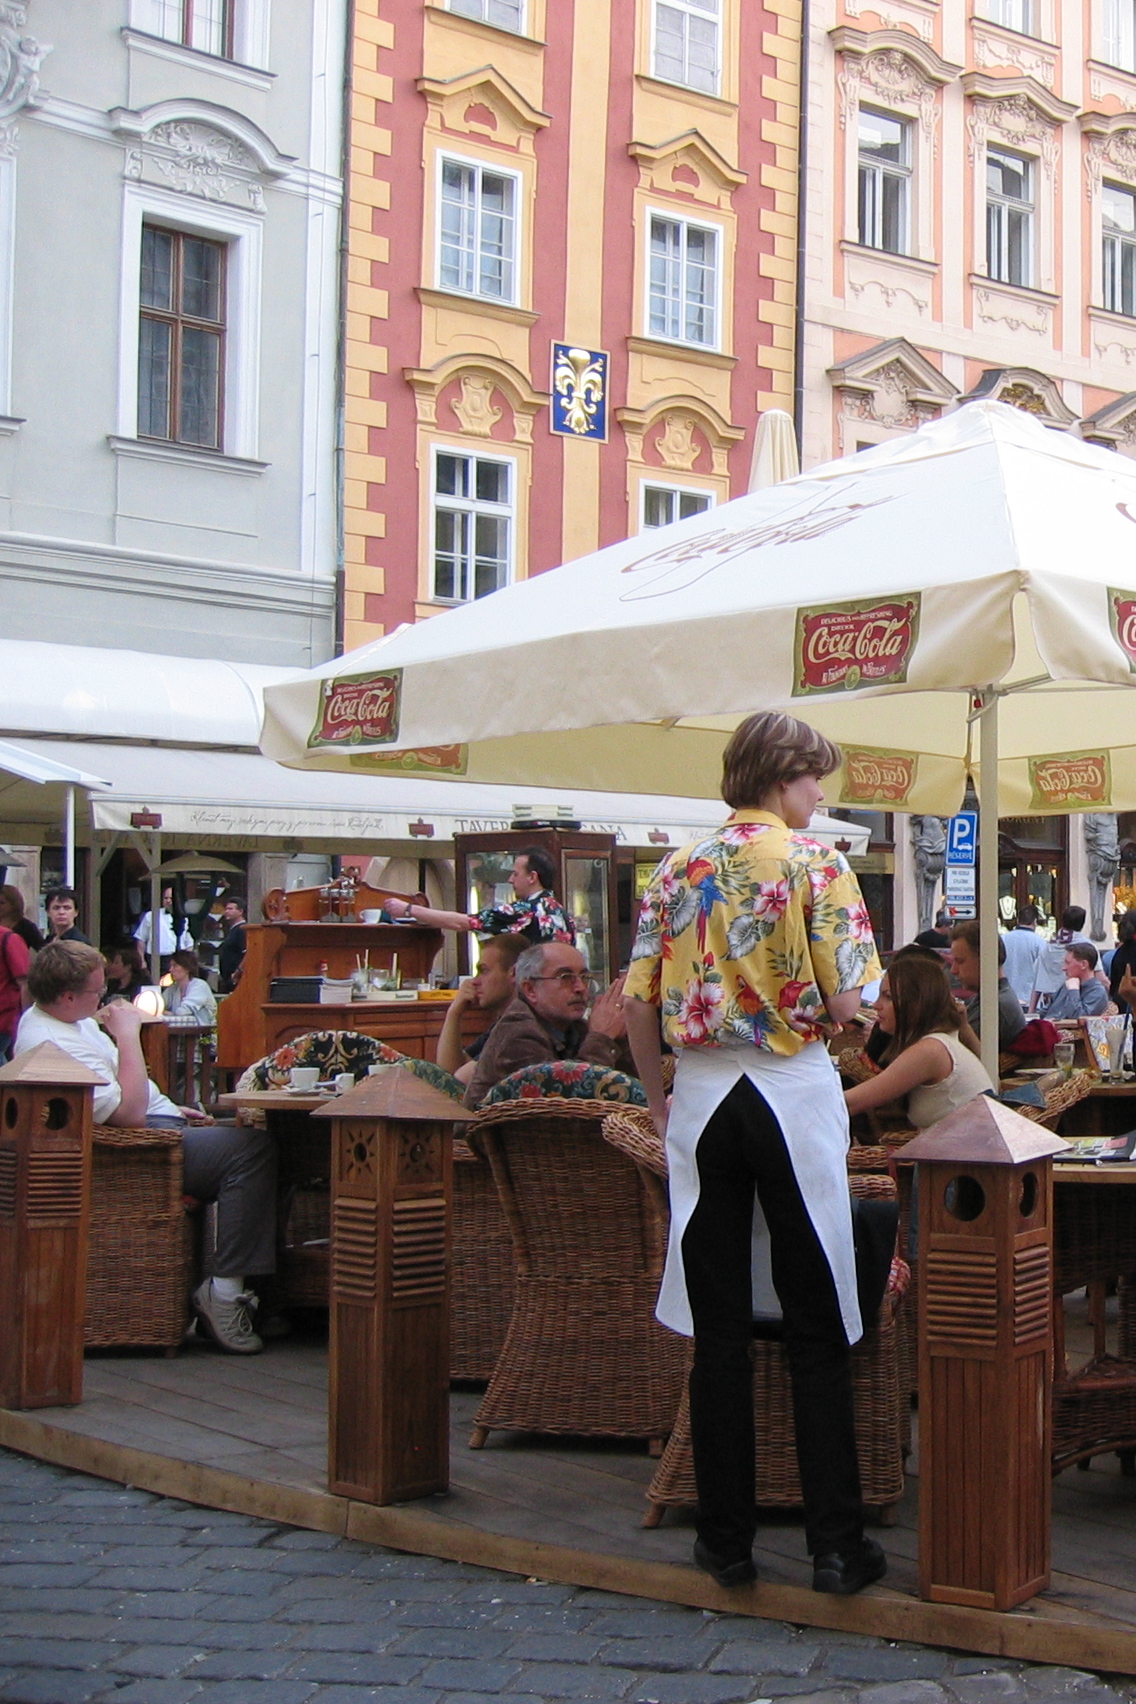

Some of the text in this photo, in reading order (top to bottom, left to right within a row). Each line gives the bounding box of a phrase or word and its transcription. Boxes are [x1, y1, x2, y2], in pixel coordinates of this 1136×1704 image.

[808, 618, 907, 663] Coca-Cola
[327, 687, 393, 724] Coca-Cola
[953, 819, 971, 848] P
